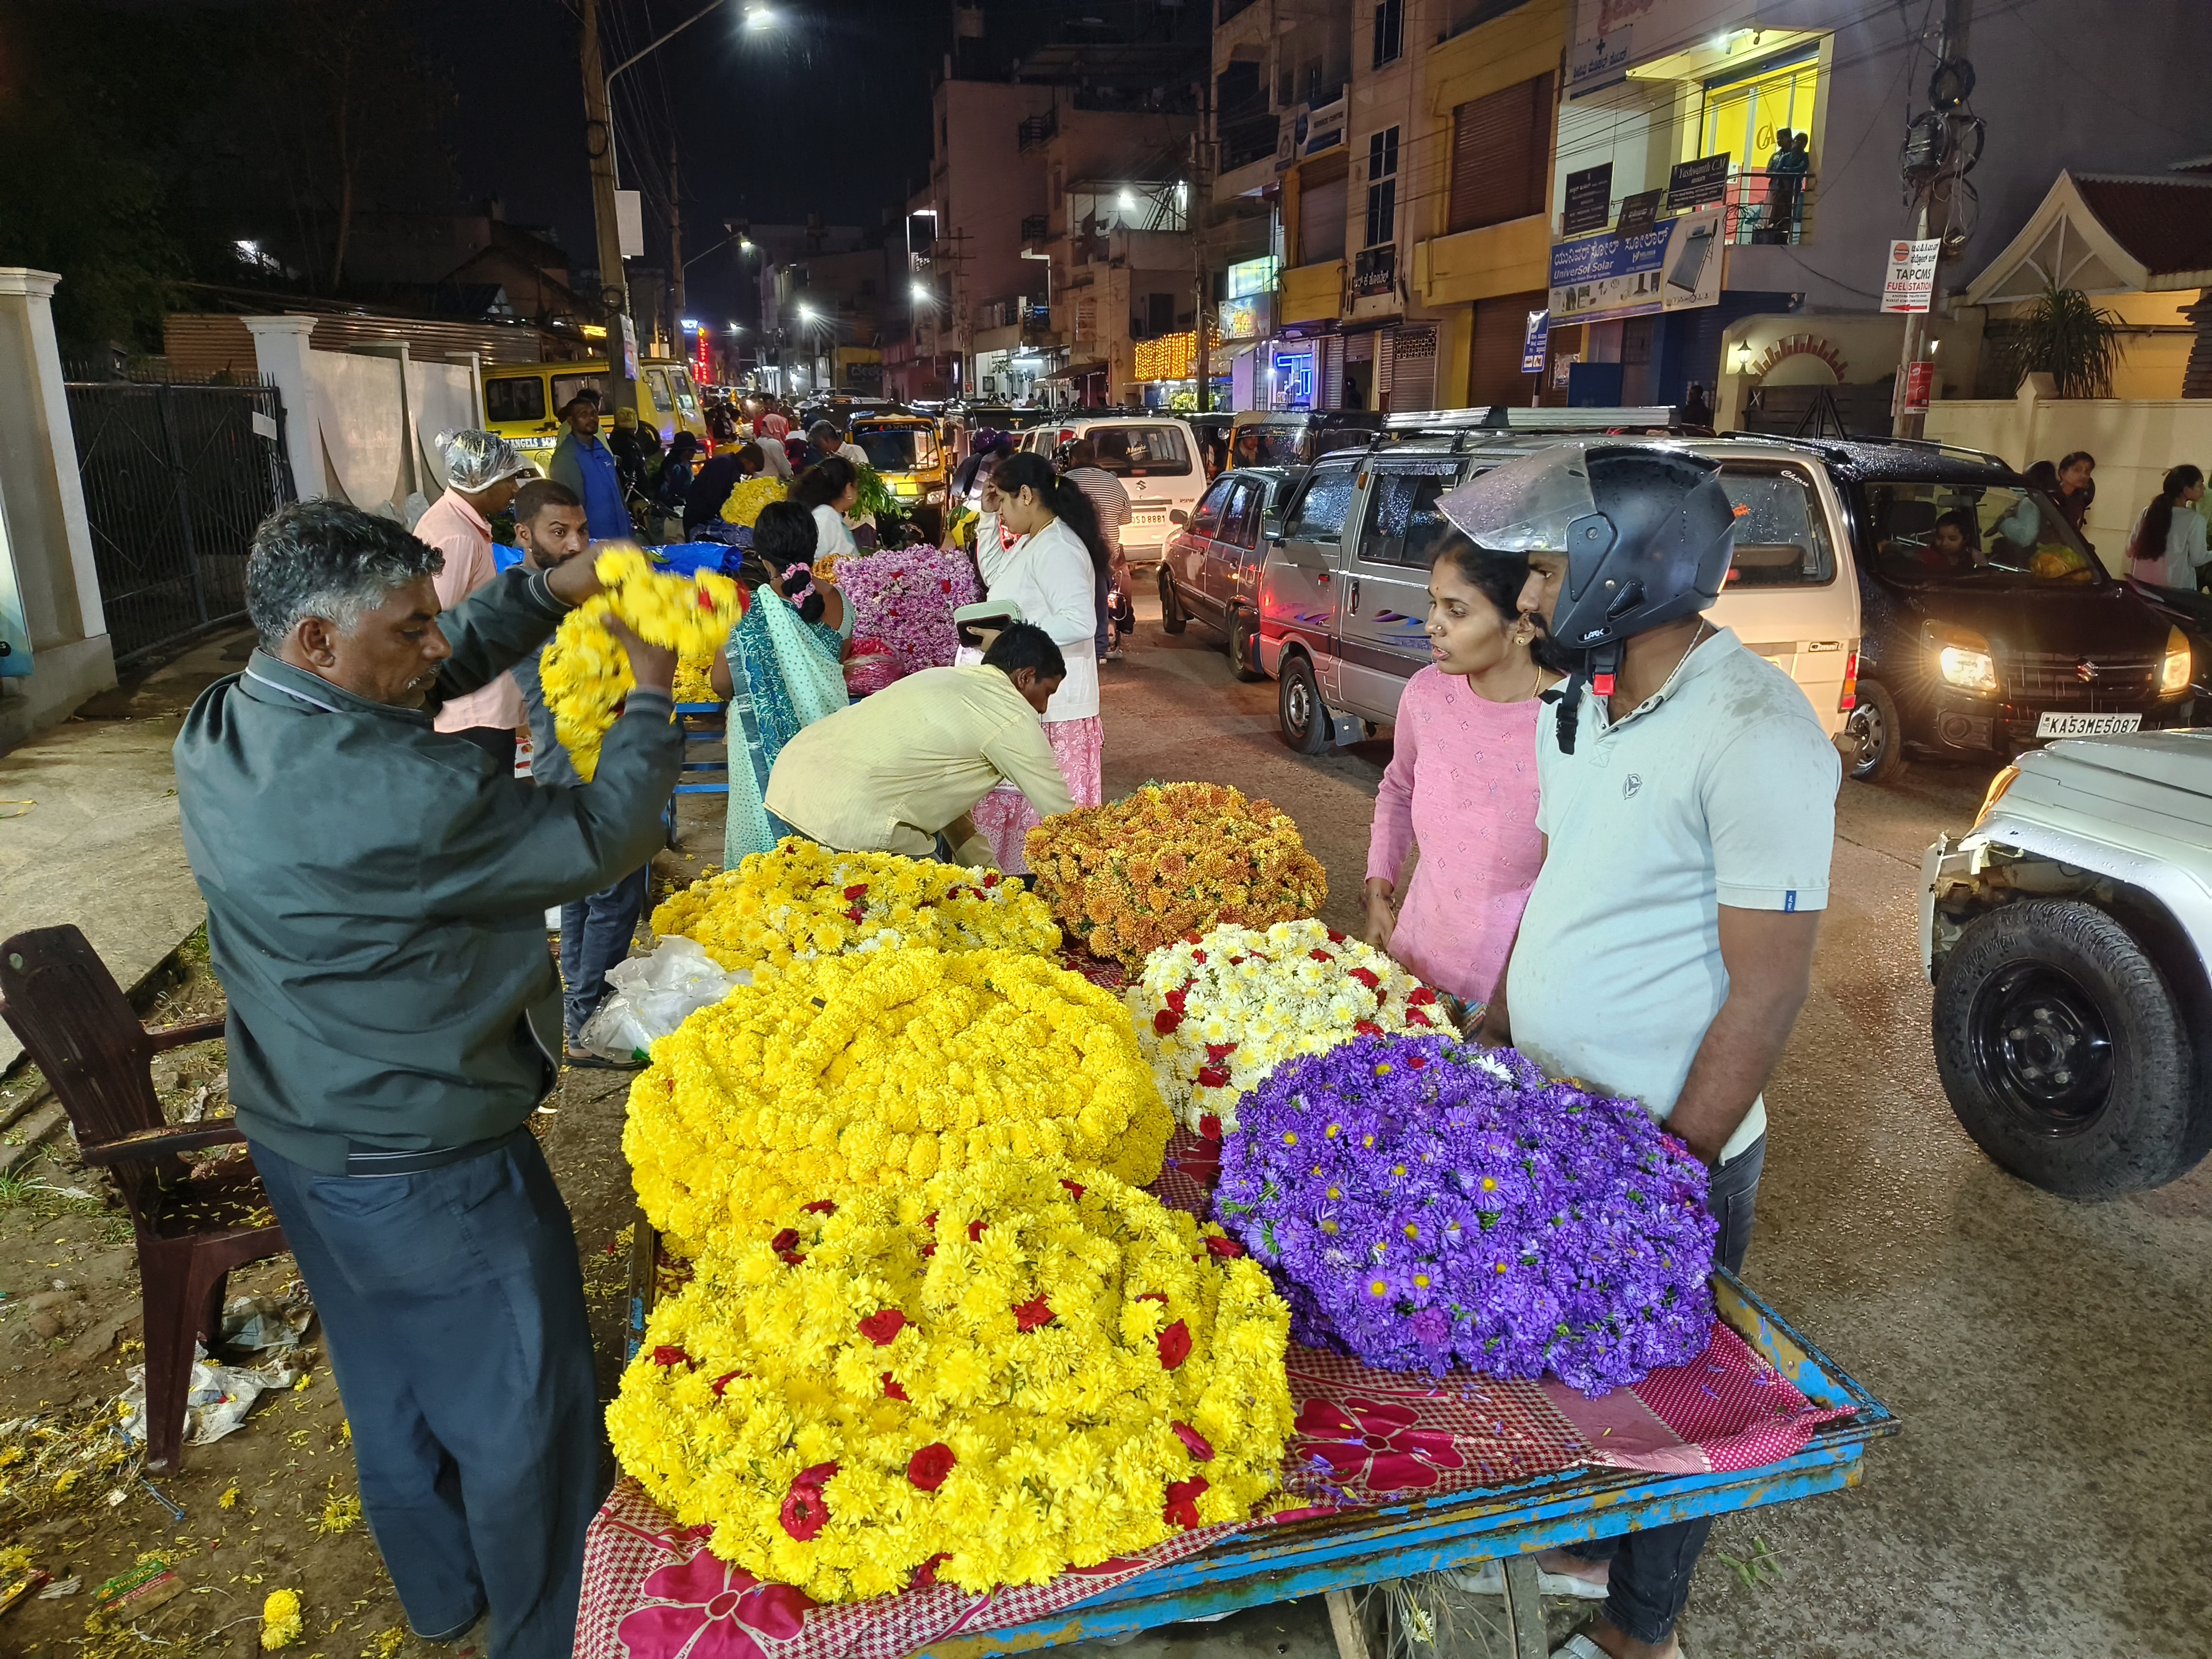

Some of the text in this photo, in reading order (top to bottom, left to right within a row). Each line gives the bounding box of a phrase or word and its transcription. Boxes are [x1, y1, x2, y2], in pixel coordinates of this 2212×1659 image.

[1679, 161, 1711, 179] Yashwanth
[1554, 263, 1591, 280] UniverSol
[1591, 260, 1615, 272] Solar
[1896, 268, 1931, 280] TAPCMS
[1887, 282, 1932, 291] FUEL STATION
[510, 438, 539, 449] ANGELS
[541, 436, 558, 448] SCH
[1125, 444, 1147, 454] Manju
[2049, 718, 2139, 734] KA53ME5087
